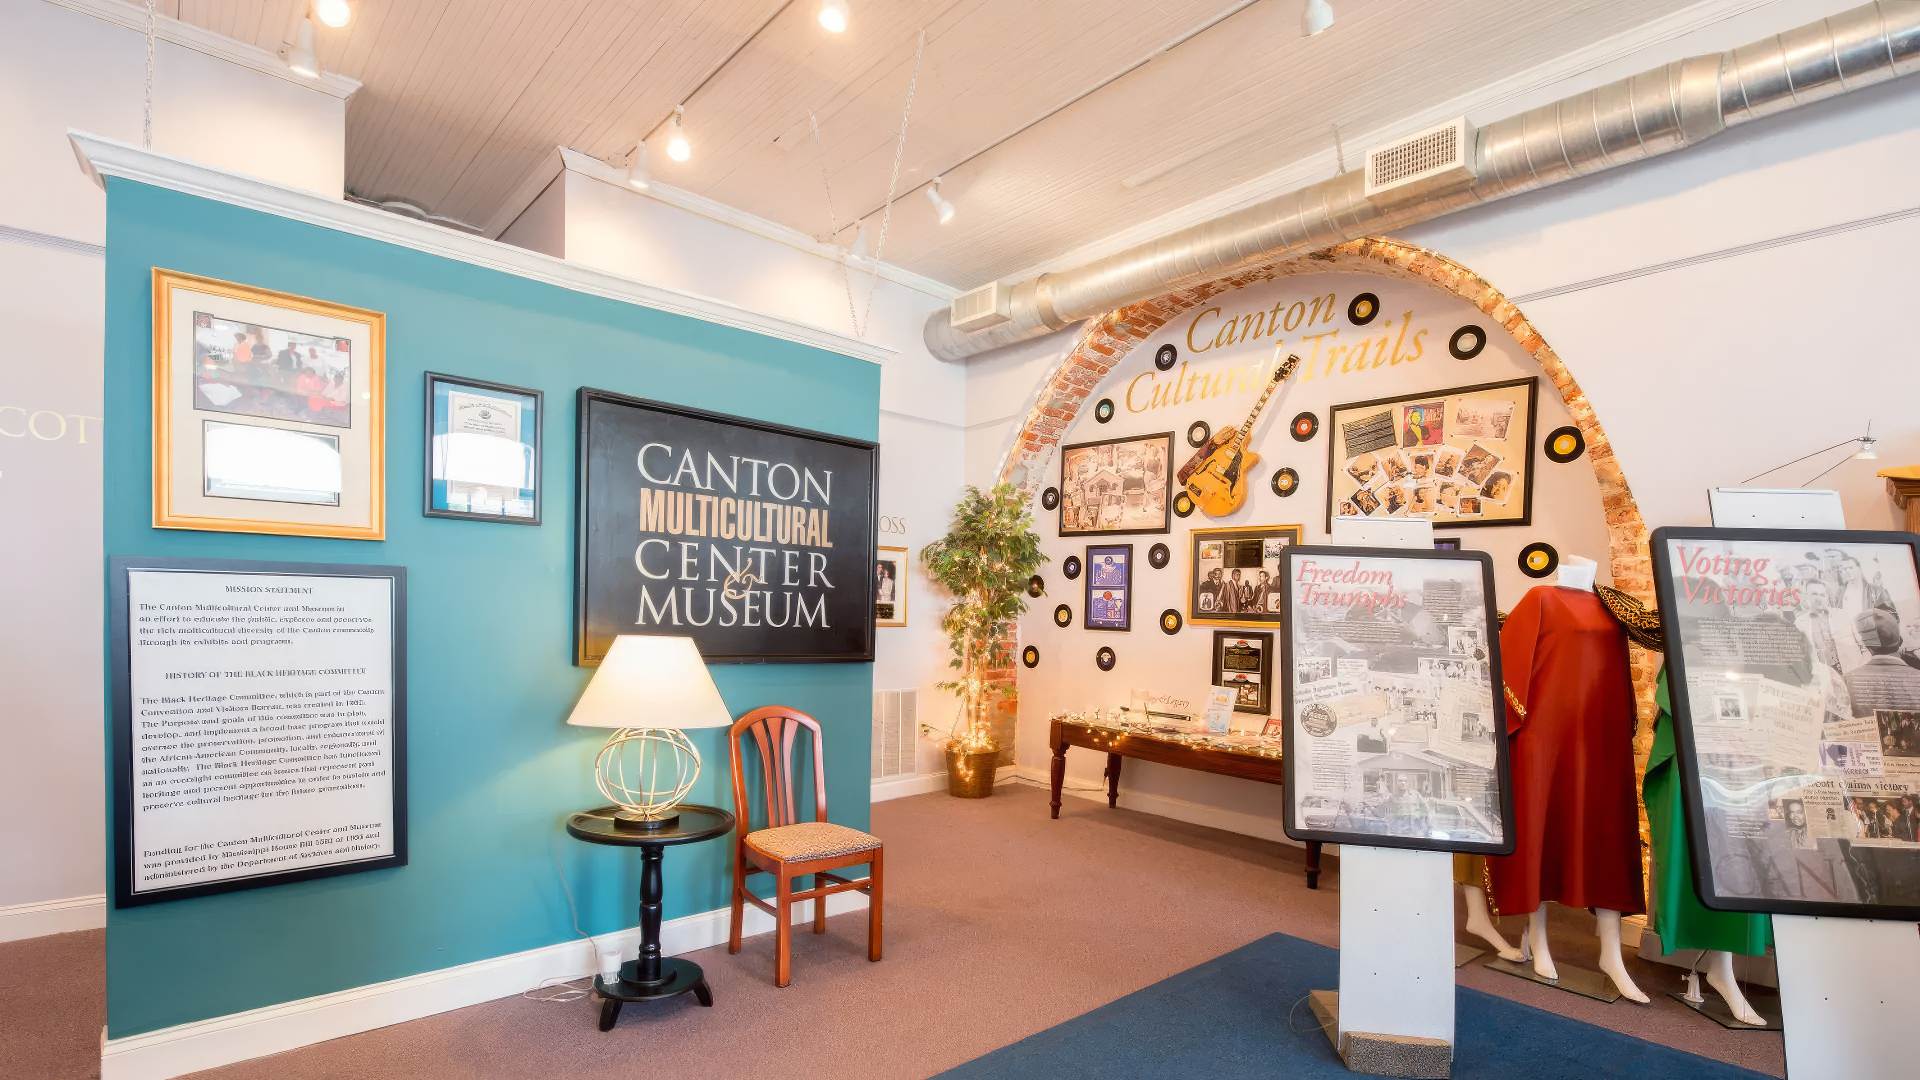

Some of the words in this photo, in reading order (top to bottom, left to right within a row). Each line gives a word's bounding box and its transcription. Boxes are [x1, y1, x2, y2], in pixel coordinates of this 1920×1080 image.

[1187, 293, 1336, 353] Canton
[1301, 310, 1429, 382] Trails
[637, 442, 833, 506] CANTON
[639, 487, 833, 548] MULTICULTURAL
[635, 538, 835, 589] CENTER
[723, 557, 768, 600] &
[1296, 559, 1393, 586] Freedom
[1676, 544, 1770, 586] Voting
[634, 584, 830, 629] MUSEUM
[1299, 582, 1408, 617] Triumphs
[1681, 575, 1802, 608] Victories
